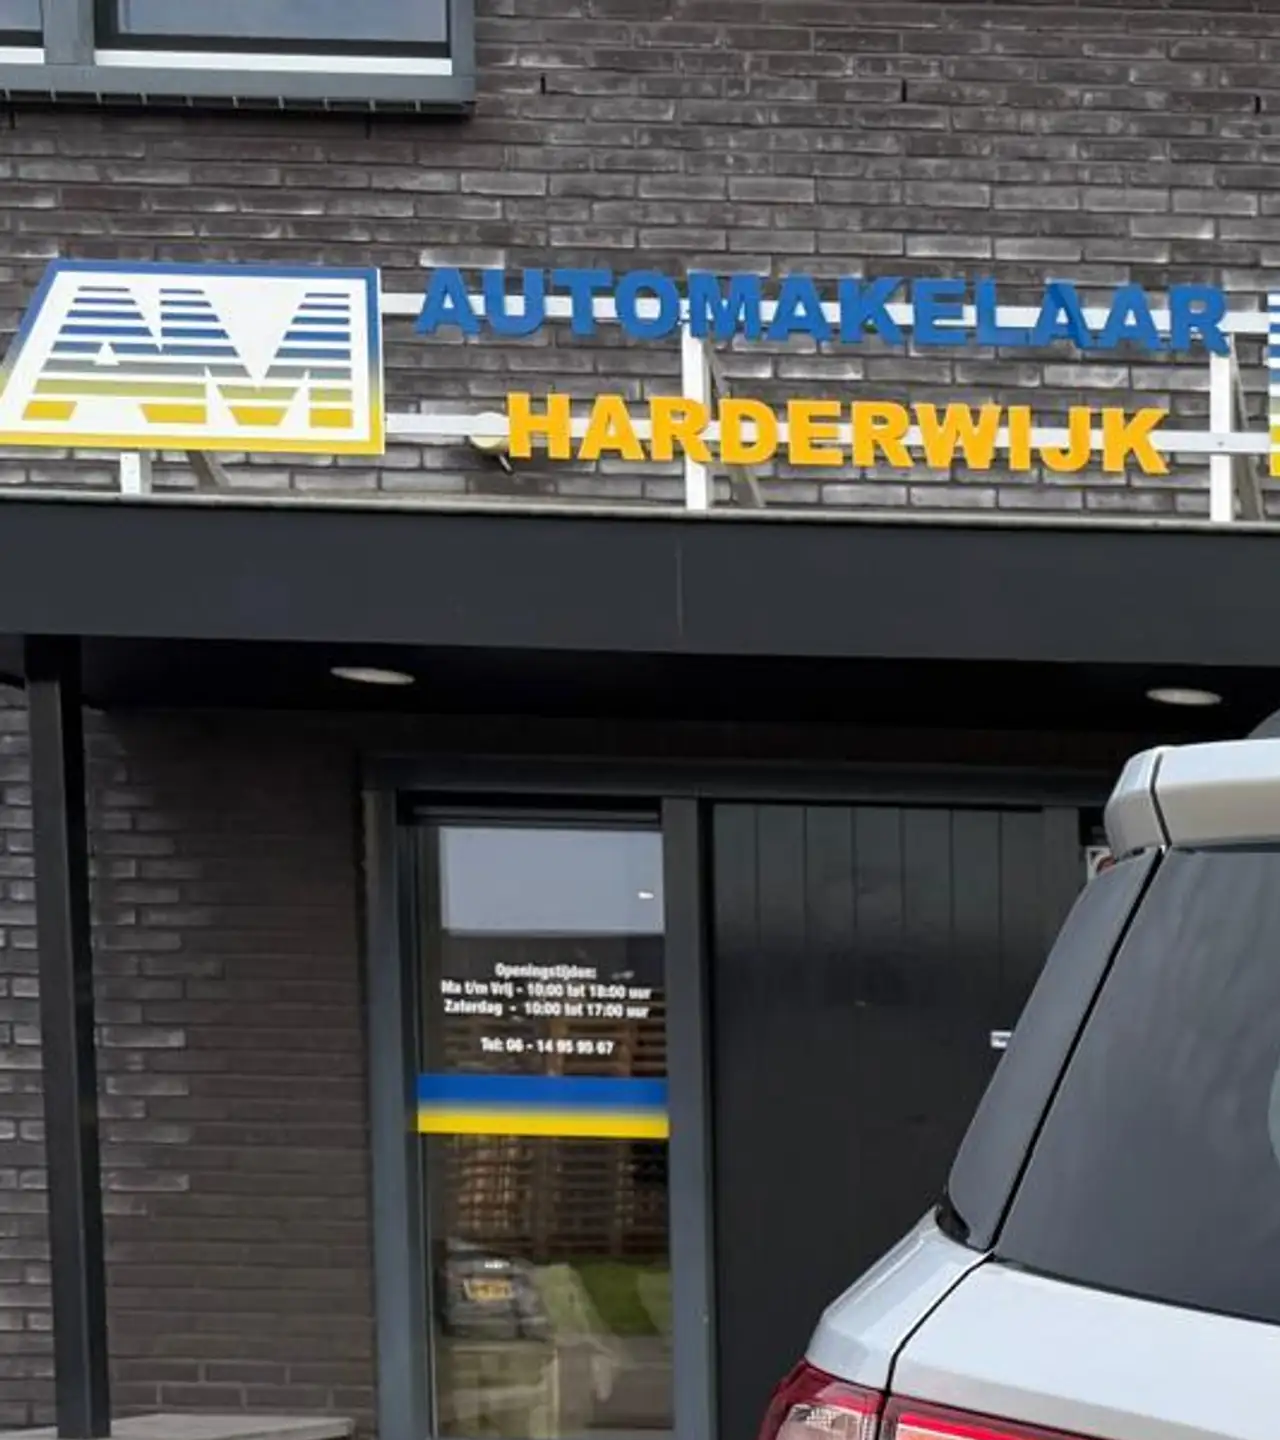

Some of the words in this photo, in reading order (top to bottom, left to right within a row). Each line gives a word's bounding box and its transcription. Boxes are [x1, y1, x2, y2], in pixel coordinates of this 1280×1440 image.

[415, 266, 1230, 354] AUTOMAKELAAR
[506, 391, 1170, 475] HARDERWIJK
[628, 988, 652, 1000] uur
[525, 1001, 562, 1016] 10:00
[626, 1007, 650, 1019] uur
[506, 1038, 524, 1052] 06
[536, 1039, 554, 1053] 14
[556, 1040, 574, 1054] 95
[576, 1040, 594, 1055] 95
[596, 1041, 615, 1055] 67
